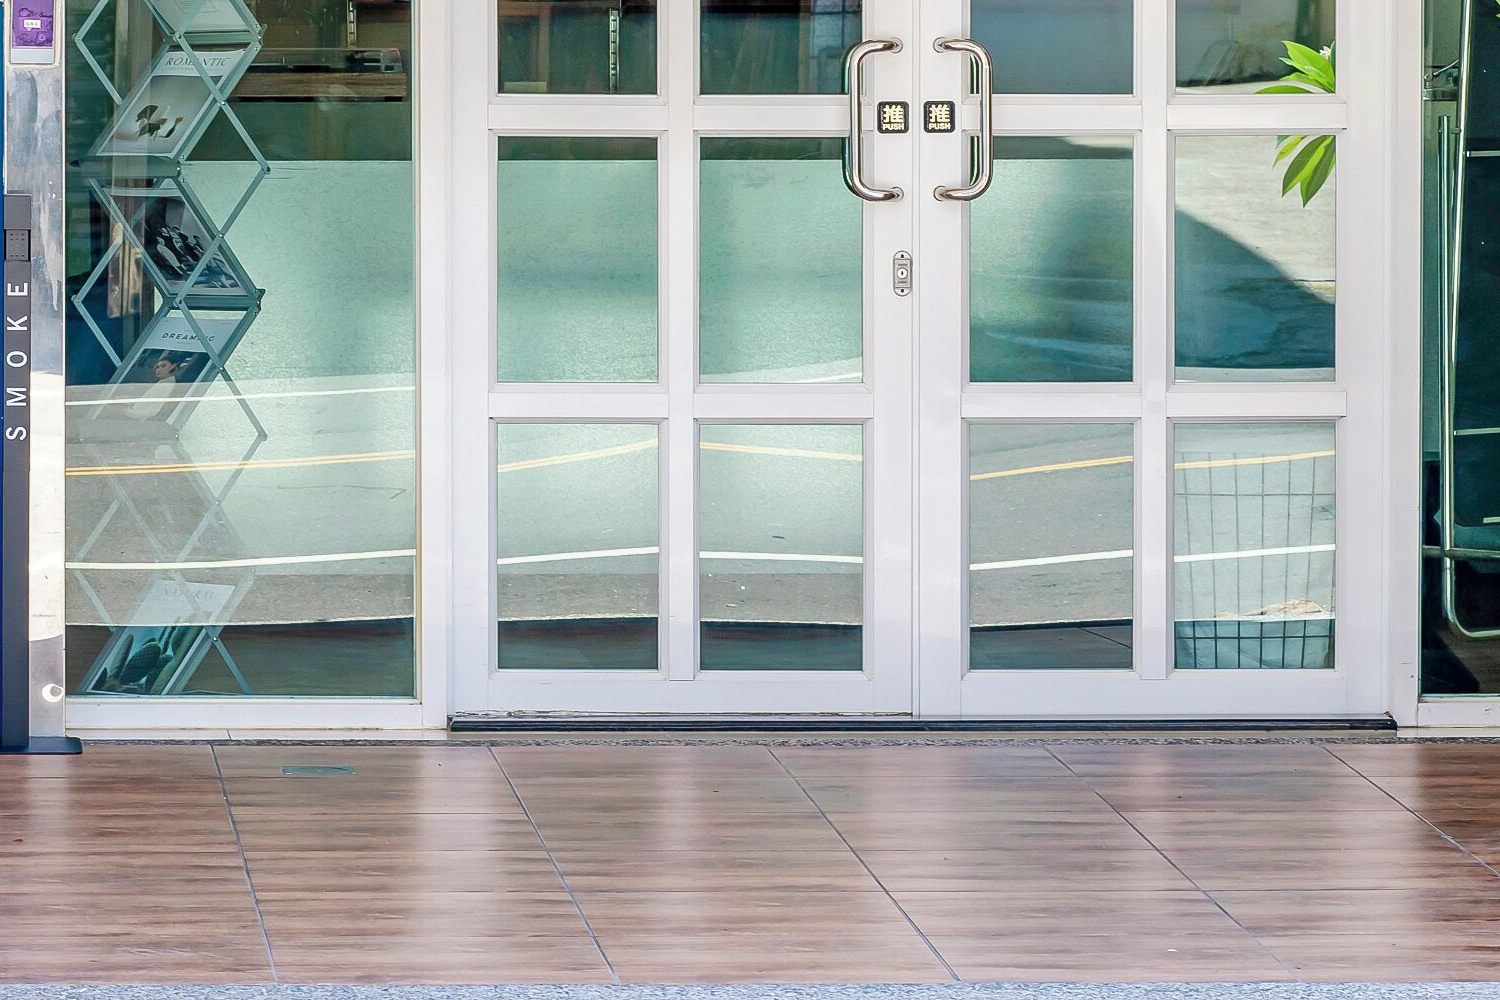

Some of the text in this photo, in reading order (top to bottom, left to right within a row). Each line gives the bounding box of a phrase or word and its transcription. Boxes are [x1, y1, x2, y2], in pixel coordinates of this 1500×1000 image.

[165, 56, 232, 67] ROMNTIC
[882, 104, 905, 123] 推
[929, 104, 951, 123] 推
[882, 122, 905, 131] PUSH
[928, 122, 951, 130] PUSH
[6, 282, 28, 441] SMOKE
